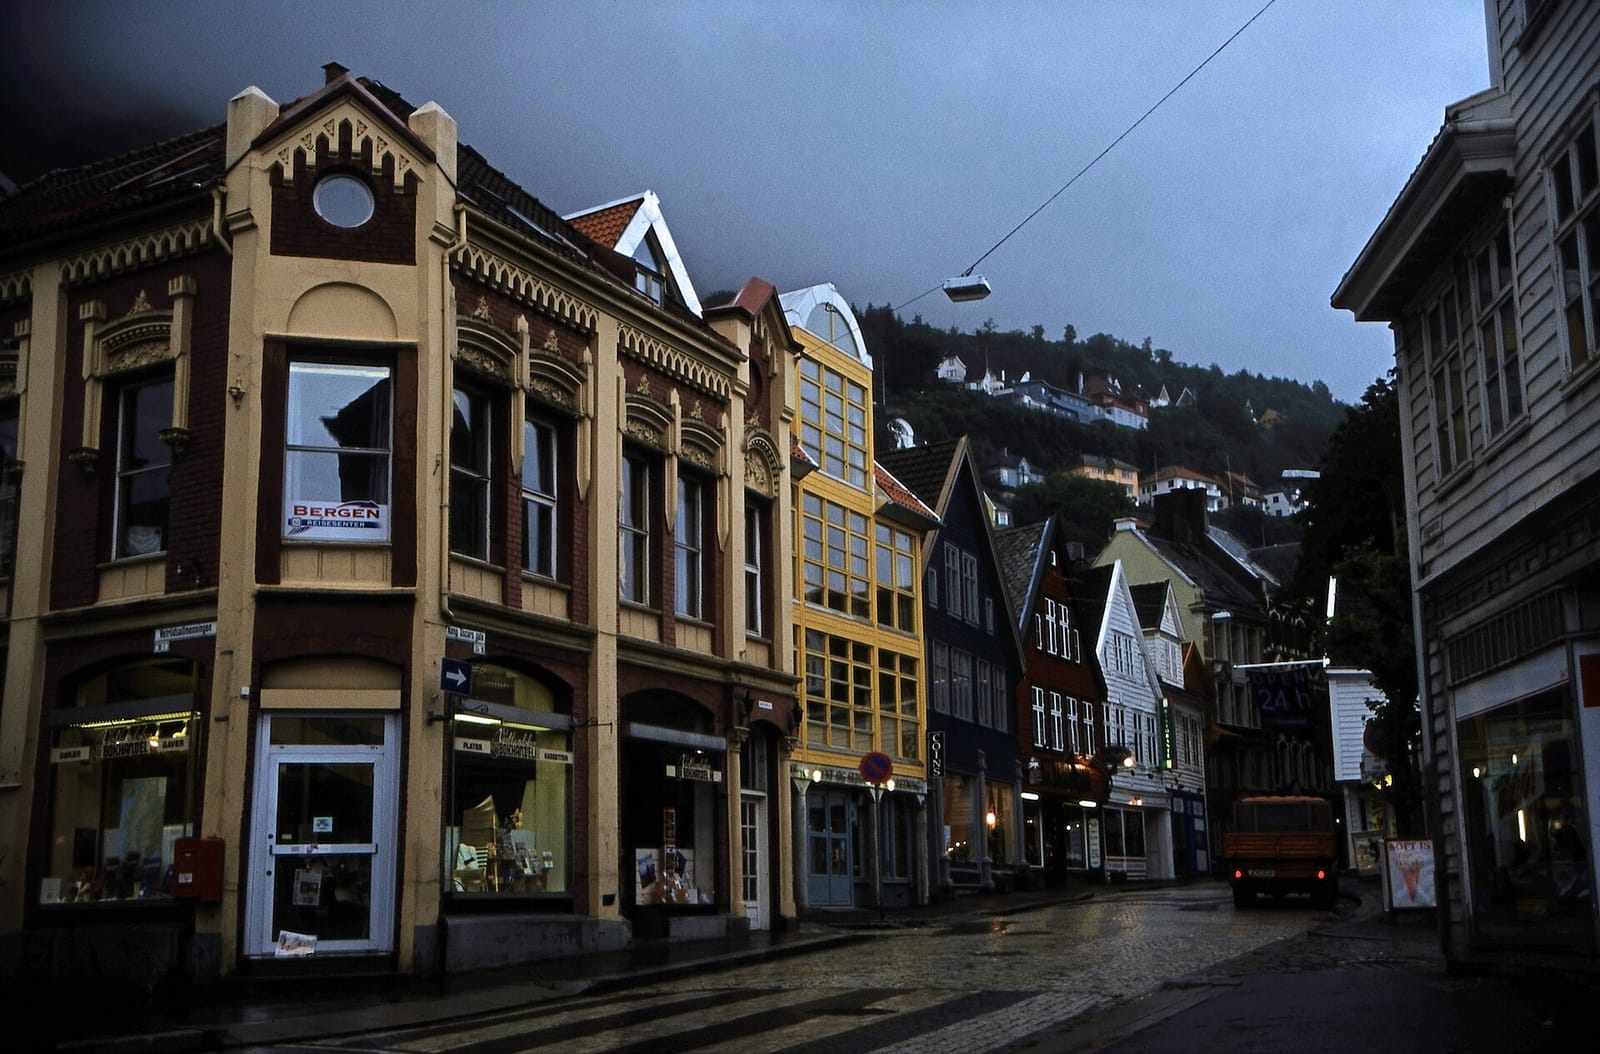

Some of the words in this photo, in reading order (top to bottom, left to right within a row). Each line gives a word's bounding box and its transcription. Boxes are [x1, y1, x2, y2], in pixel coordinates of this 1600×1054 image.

[293, 505, 380, 519] BERGEN
[306, 520, 365, 528] REISESENTER
[1258, 688, 1289, 711] 24
[931, 733, 942, 777] COINS
[1390, 841, 1416, 851] SOFT
[1420, 840, 1431, 849] IS
